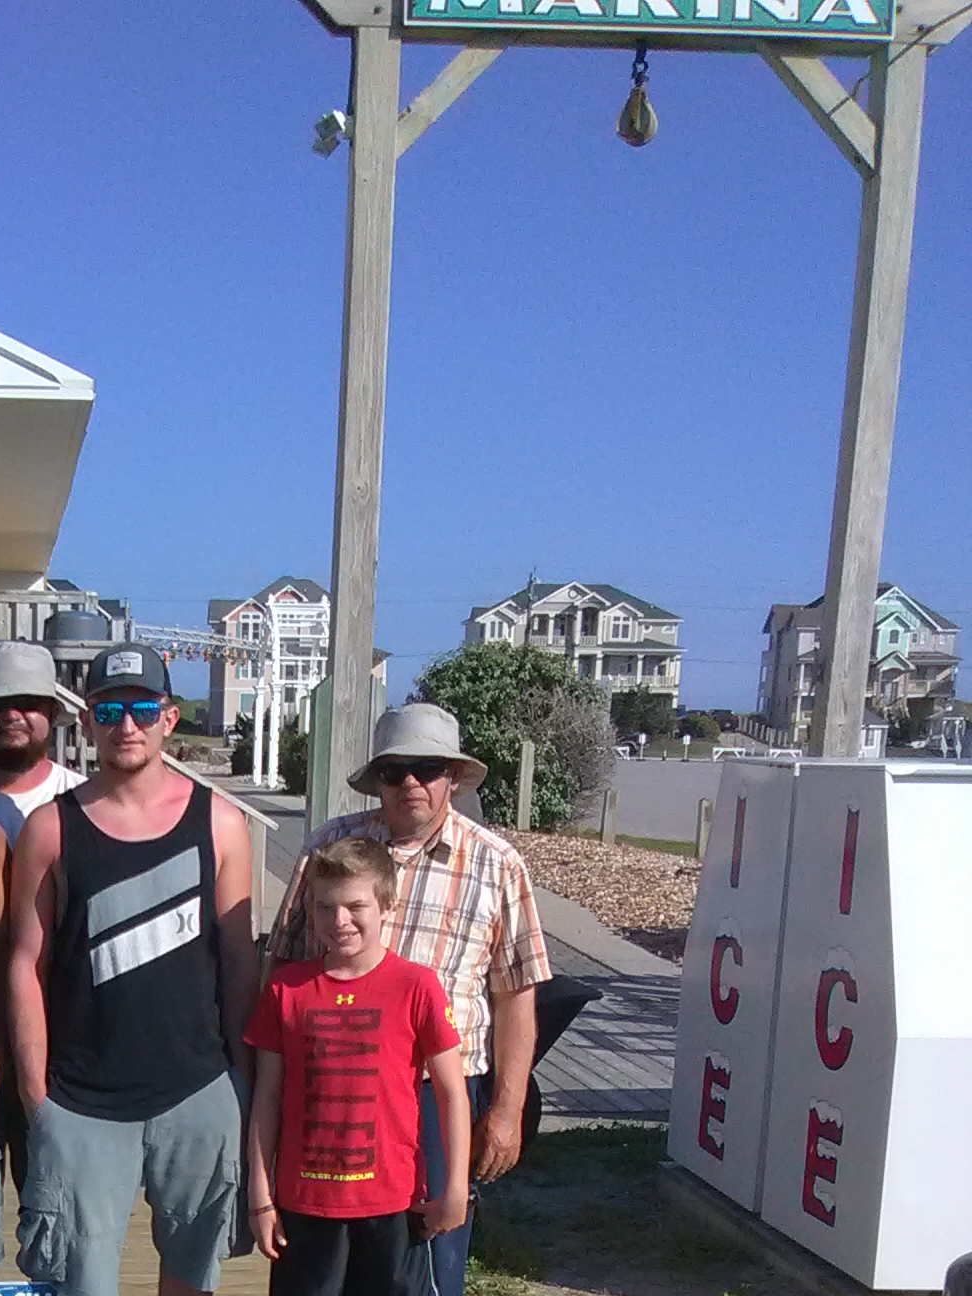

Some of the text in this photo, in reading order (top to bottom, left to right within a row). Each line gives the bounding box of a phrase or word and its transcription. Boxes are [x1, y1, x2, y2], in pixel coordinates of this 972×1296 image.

[698, 786, 747, 1161] ICE
[802, 801, 860, 1228] ICE
[333, 1172, 375, 1182] ARMOUR
